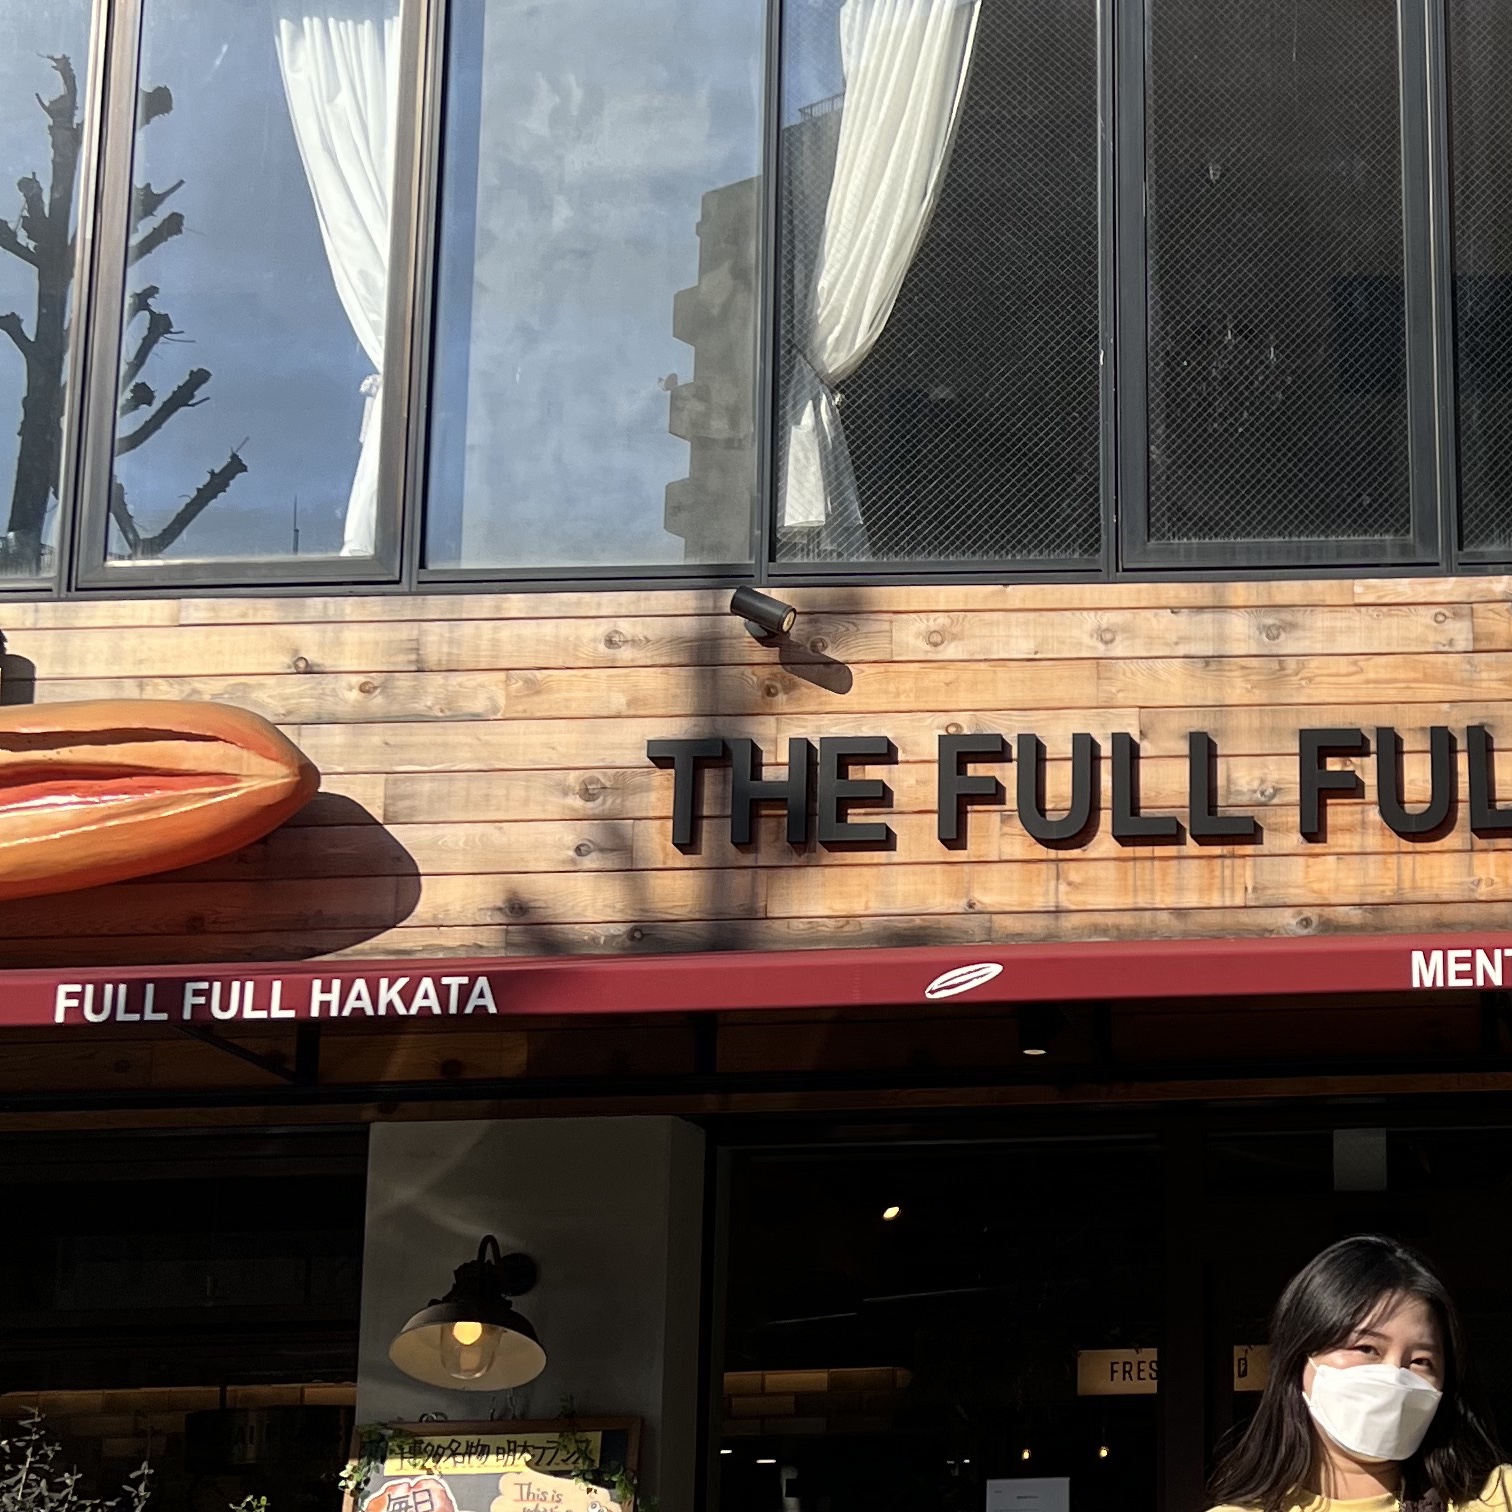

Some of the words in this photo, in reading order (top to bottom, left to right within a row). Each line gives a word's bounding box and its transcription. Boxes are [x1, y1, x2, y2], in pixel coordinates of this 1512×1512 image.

[647, 736, 896, 853] THE
[938, 731, 1263, 850] FULL
[54, 982, 169, 1023] FULL
[181, 979, 296, 1020] FULL
[310, 976, 498, 1017] HAKATA
[514, 1482, 548, 1502] This
[551, 1489, 563, 1503] is
